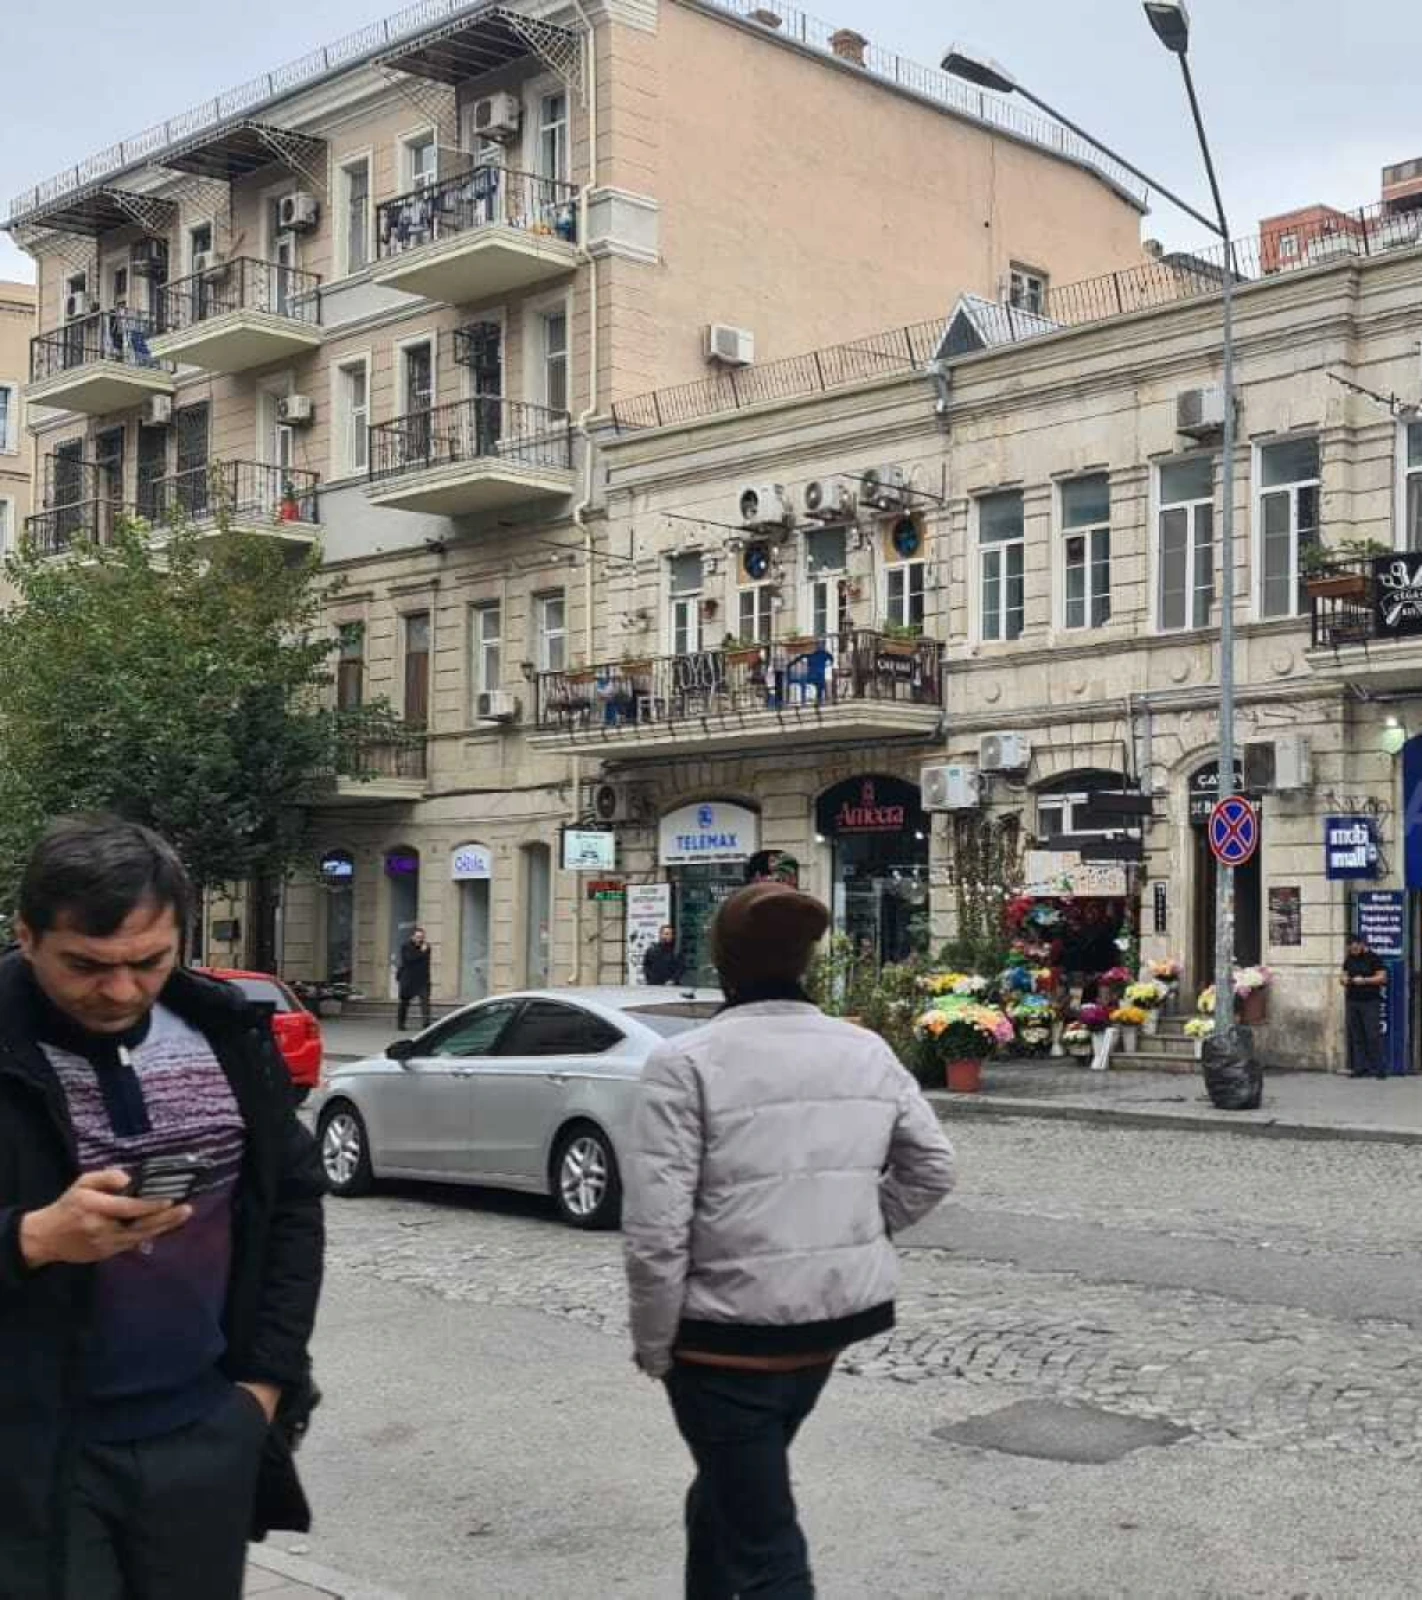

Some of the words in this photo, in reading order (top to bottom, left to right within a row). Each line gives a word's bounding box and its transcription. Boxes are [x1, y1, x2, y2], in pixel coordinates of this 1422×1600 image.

[675, 832, 737, 851] TELEMAX
[1330, 823, 1369, 846] mobi
[1330, 846, 1367, 868] mall
